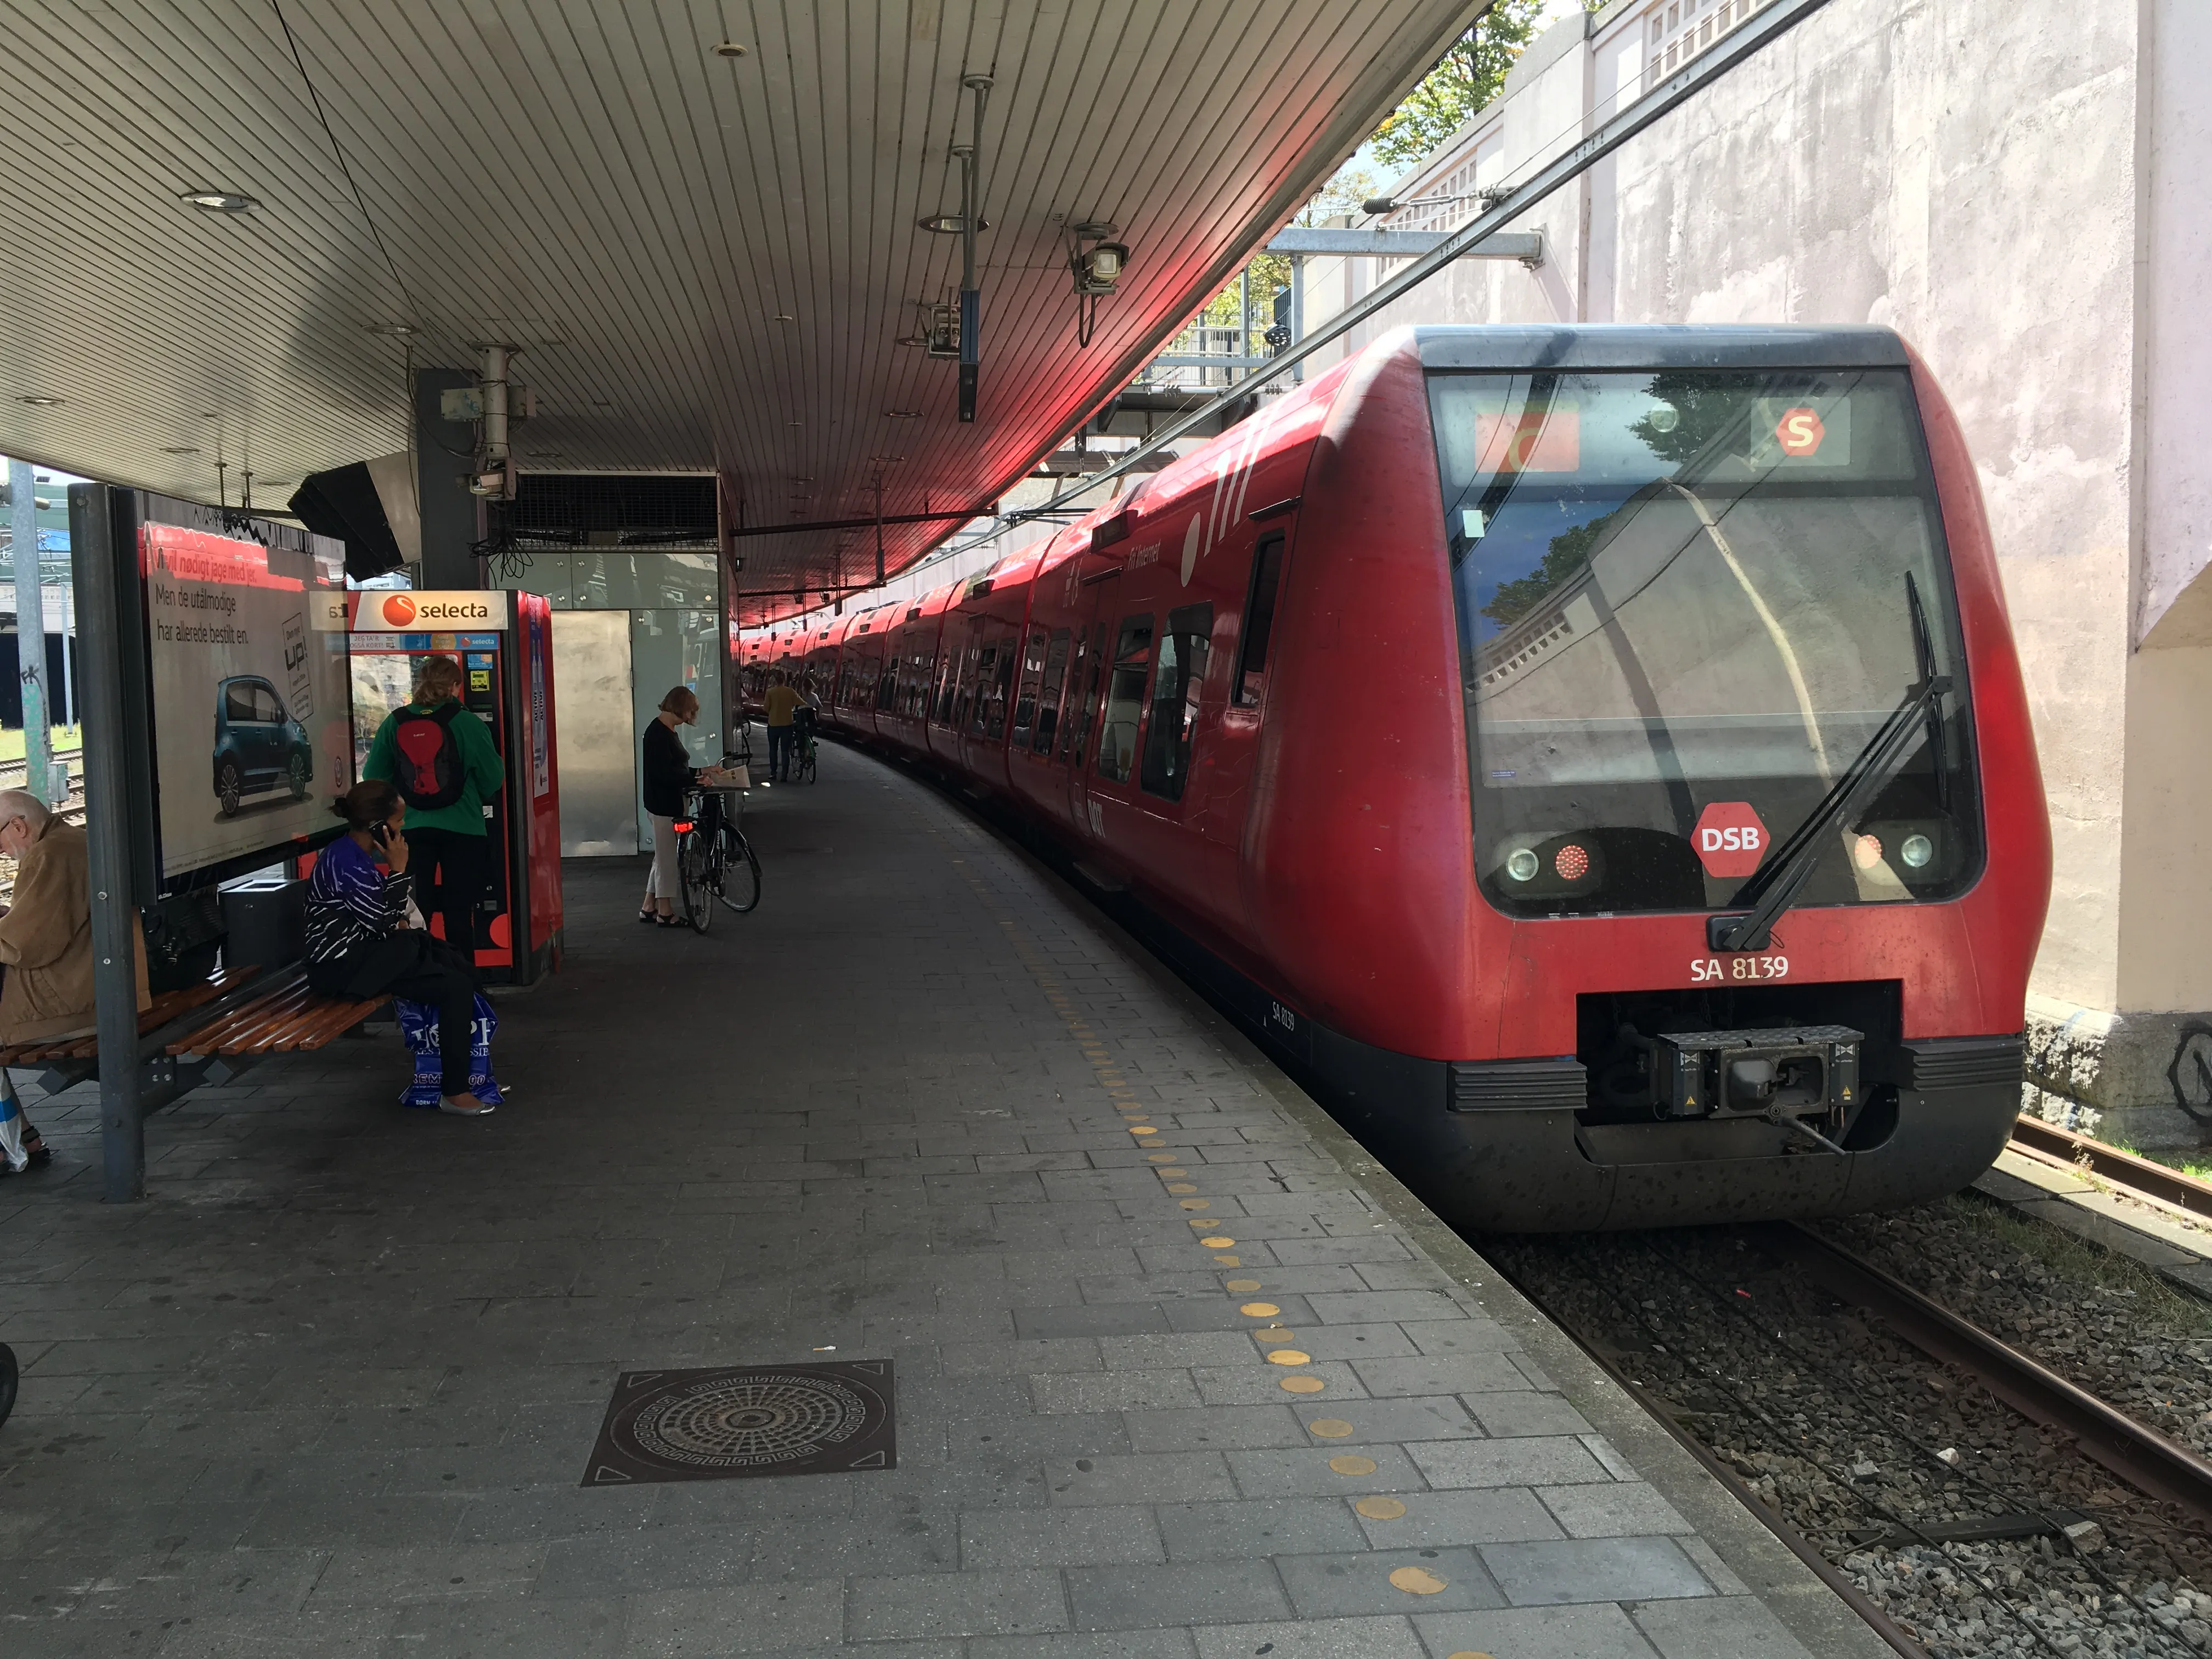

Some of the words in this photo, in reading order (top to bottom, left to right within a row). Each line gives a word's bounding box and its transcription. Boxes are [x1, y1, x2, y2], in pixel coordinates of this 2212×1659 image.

[1787, 416, 1814, 447] S
[180, 554, 209, 580] nødigt
[211, 556, 227, 583] jage
[228, 562, 245, 580] med
[246, 564, 257, 586] jer.
[1127, 546, 1138, 571] Fri
[1136, 539, 1161, 567] Internet
[155, 583, 176, 606] Men
[178, 586, 188, 607] de
[191, 588, 236, 617] utålmodige
[420, 603, 488, 618] selecta
[157, 619, 173, 641] har
[176, 620, 207, 642] allerede
[210, 623, 235, 644] bestilt
[236, 630, 249, 644] en.
[1702, 827, 1760, 851] DSB
[1691, 959, 1724, 981] SA
[1733, 956, 1789, 979] 8139
[1273, 1001, 1280, 1022] SA
[1281, 1007, 1294, 1031] 8139
